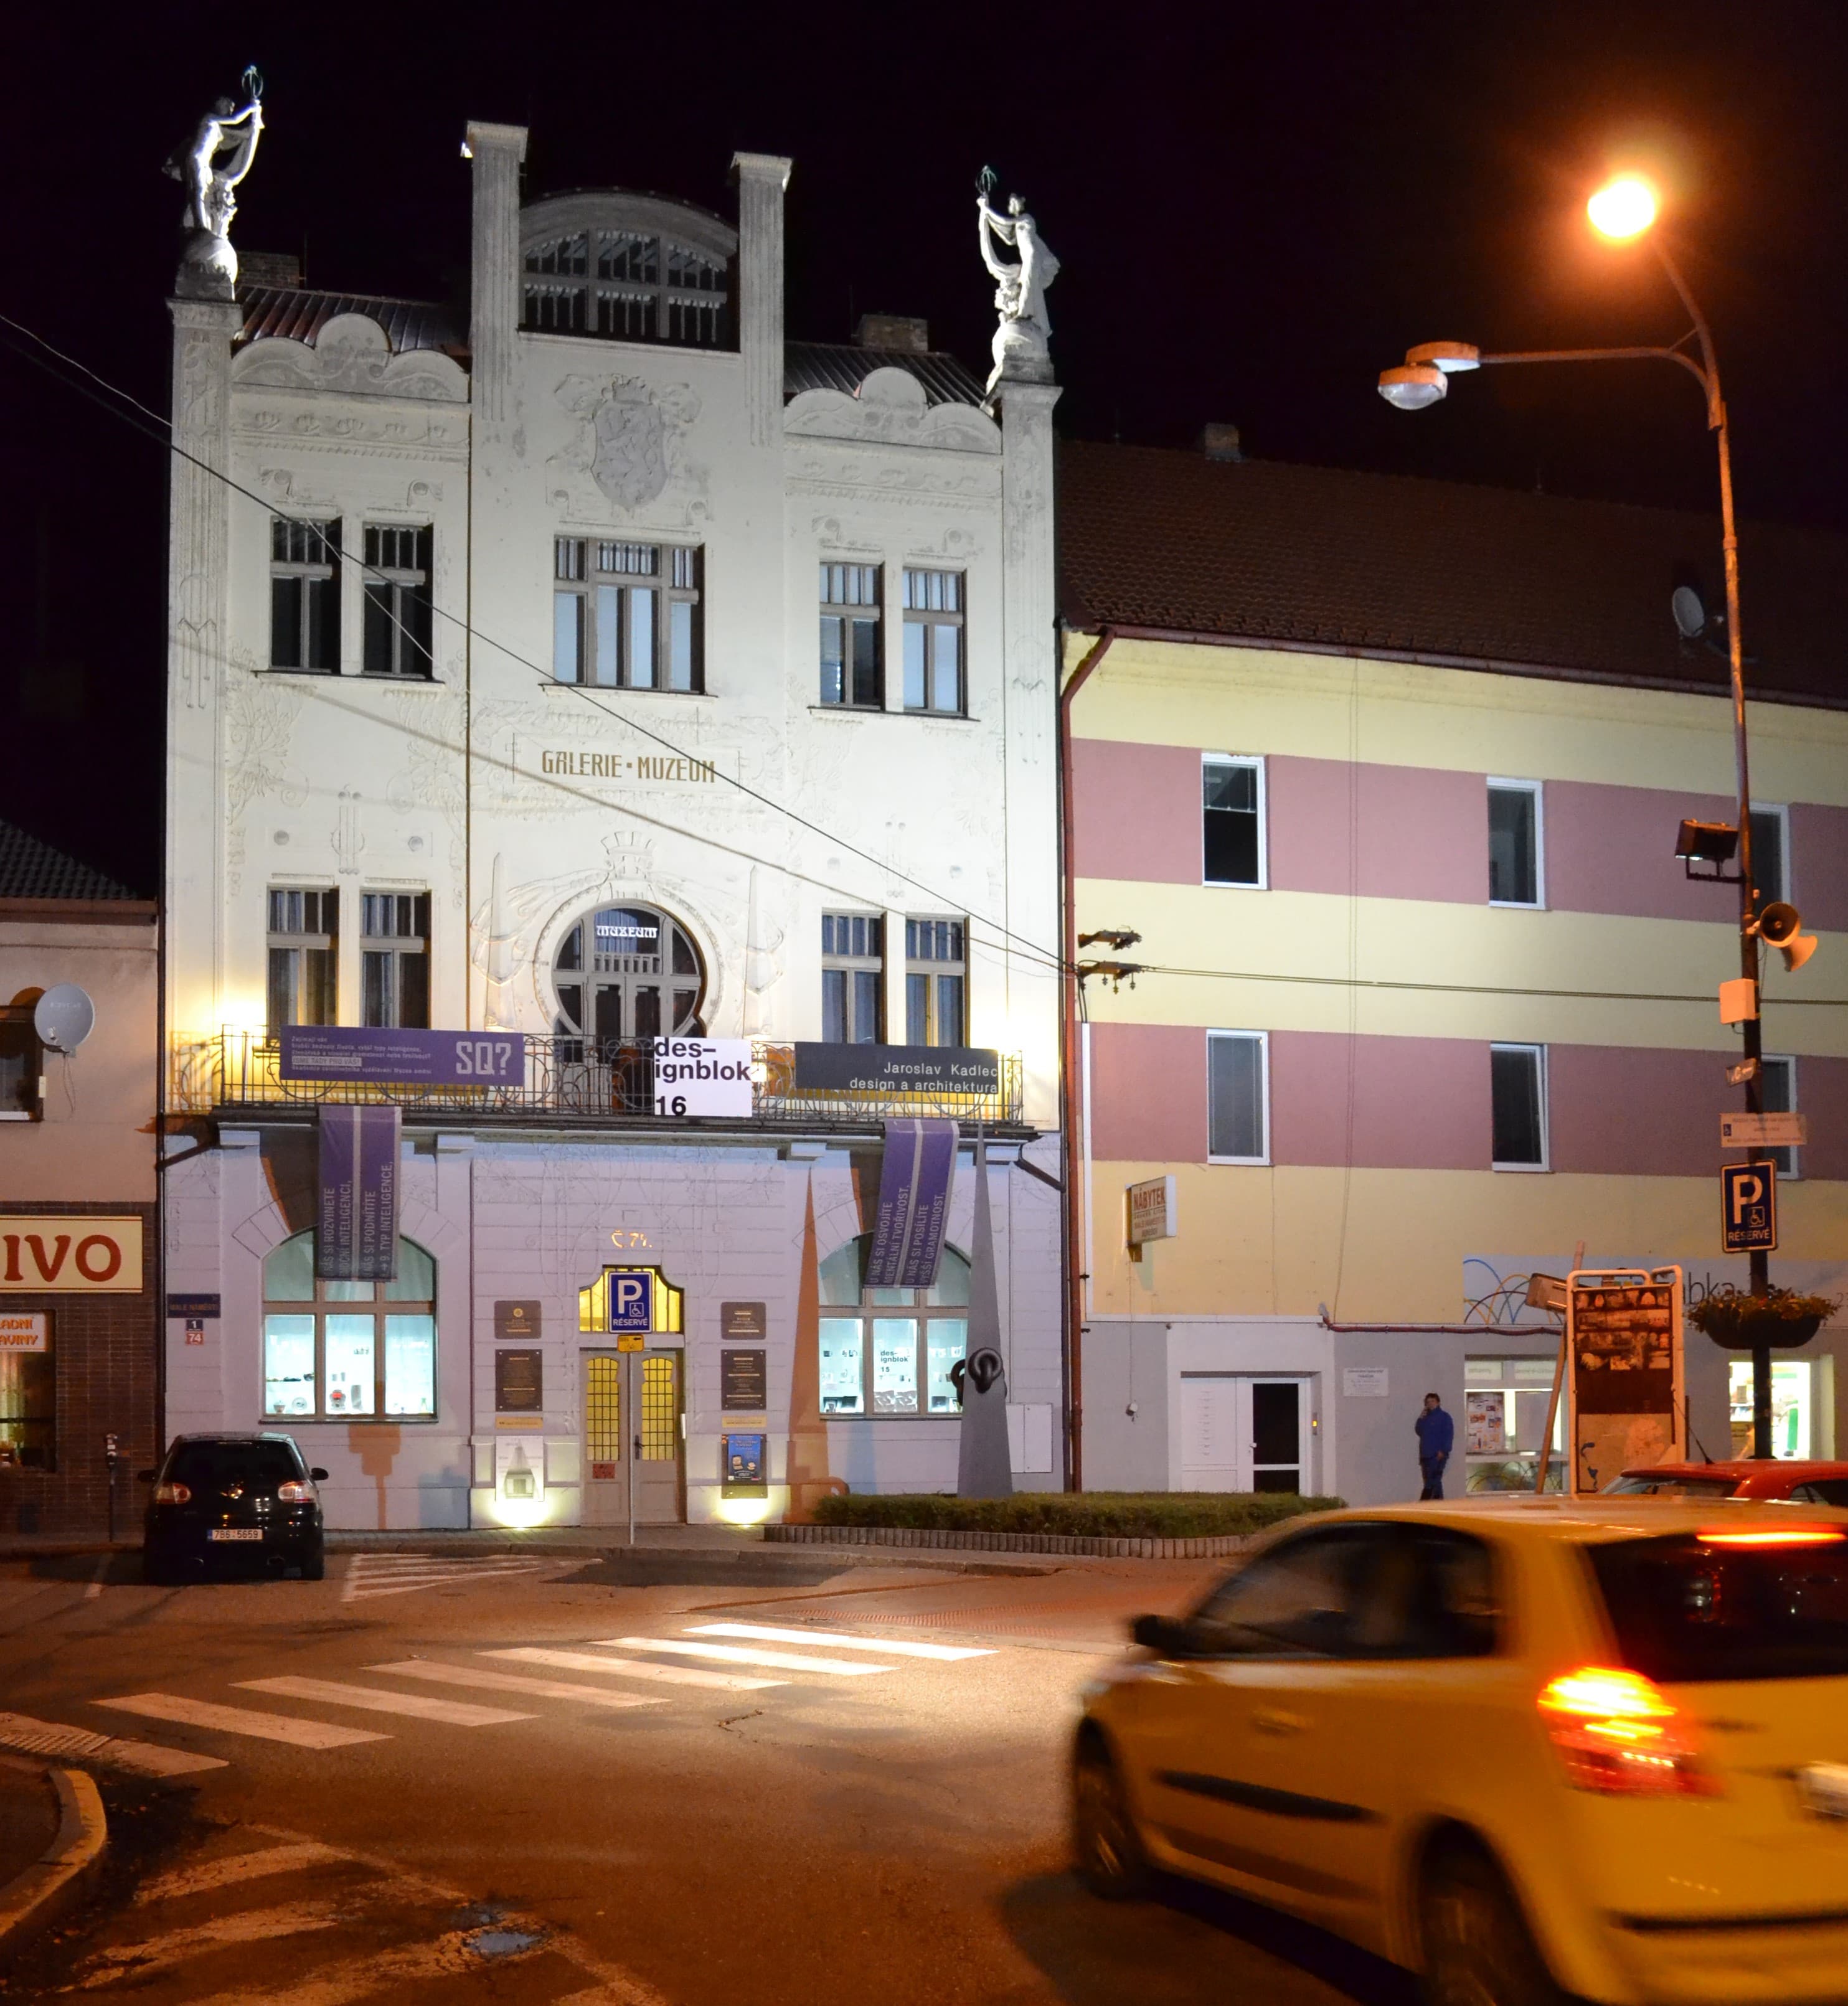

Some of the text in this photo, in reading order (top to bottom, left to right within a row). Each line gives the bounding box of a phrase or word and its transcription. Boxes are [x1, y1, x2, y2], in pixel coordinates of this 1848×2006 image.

[542, 750, 715, 783] GALERIE MUZEUM
[456, 1041, 511, 1075] SQ?
[655, 1059, 752, 1083] ignblok
[884, 1062, 997, 1077] Jaroslav Kadlec
[850, 1078, 997, 1094] design a architektura
[656, 1096, 687, 1116] 16
[380, 1161, 394, 1231] INTELIGENCE,
[1133, 1185, 1166, 1210] NÁBYTEK
[1733, 1174, 1763, 1224] P
[323, 1187, 335, 1242] ROZVINETE
[877, 1202, 893, 1245] OSVOJÍTE
[913, 1204, 929, 1246] POSÍLÍTE
[379, 1234, 391, 1250] TYP
[1728, 1228, 1771, 1241] RÉSERVÉ
[324, 1245, 334, 1254] SI
[364, 1245, 374, 1253] SI
[875, 1248, 885, 1257] SI
[912, 1248, 922, 1257] SI
[870, 1259, 884, 1276] NÁS
[906, 1259, 920, 1276] NÁS
[618, 1279, 643, 1314] P
[0, 1316, 34, 1329] ADNÍ
[192, 1321, 197, 1329] 1
[613, 1317, 648, 1326] RÉSERVÉ
[188, 1333, 201, 1342] 74
